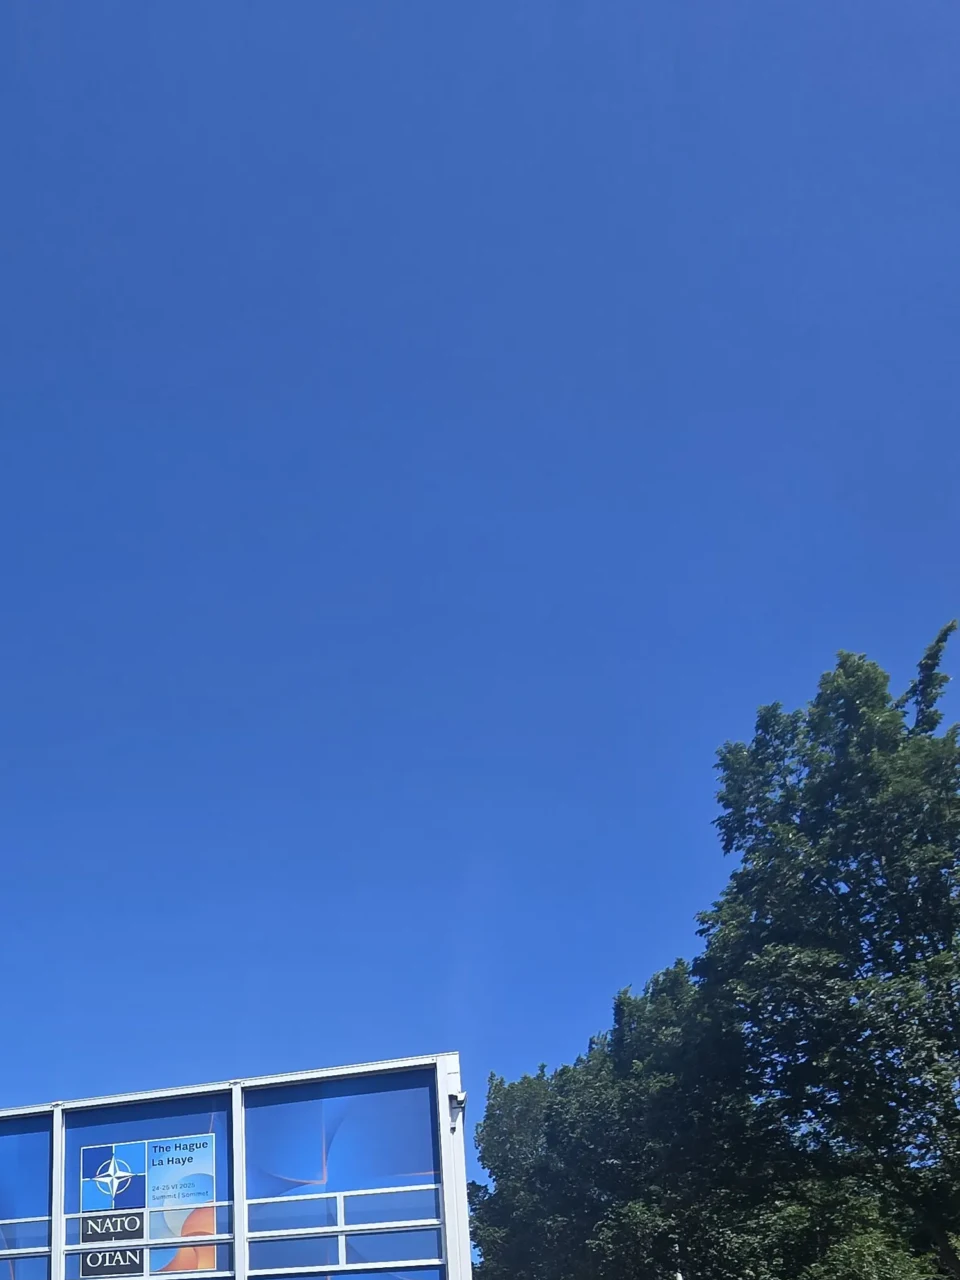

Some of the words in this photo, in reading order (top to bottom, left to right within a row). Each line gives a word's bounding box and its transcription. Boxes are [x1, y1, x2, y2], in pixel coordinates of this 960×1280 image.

[152, 1145, 171, 1153] The
[174, 1141, 209, 1152] Hague
[151, 1158, 164, 1167] La
[167, 1156, 194, 1166] Haye
[151, 1193, 176, 1201] Summit
[181, 1190, 209, 1198] Sommet
[86, 1216, 141, 1235] NATO
[86, 1250, 141, 1268] OTAN
